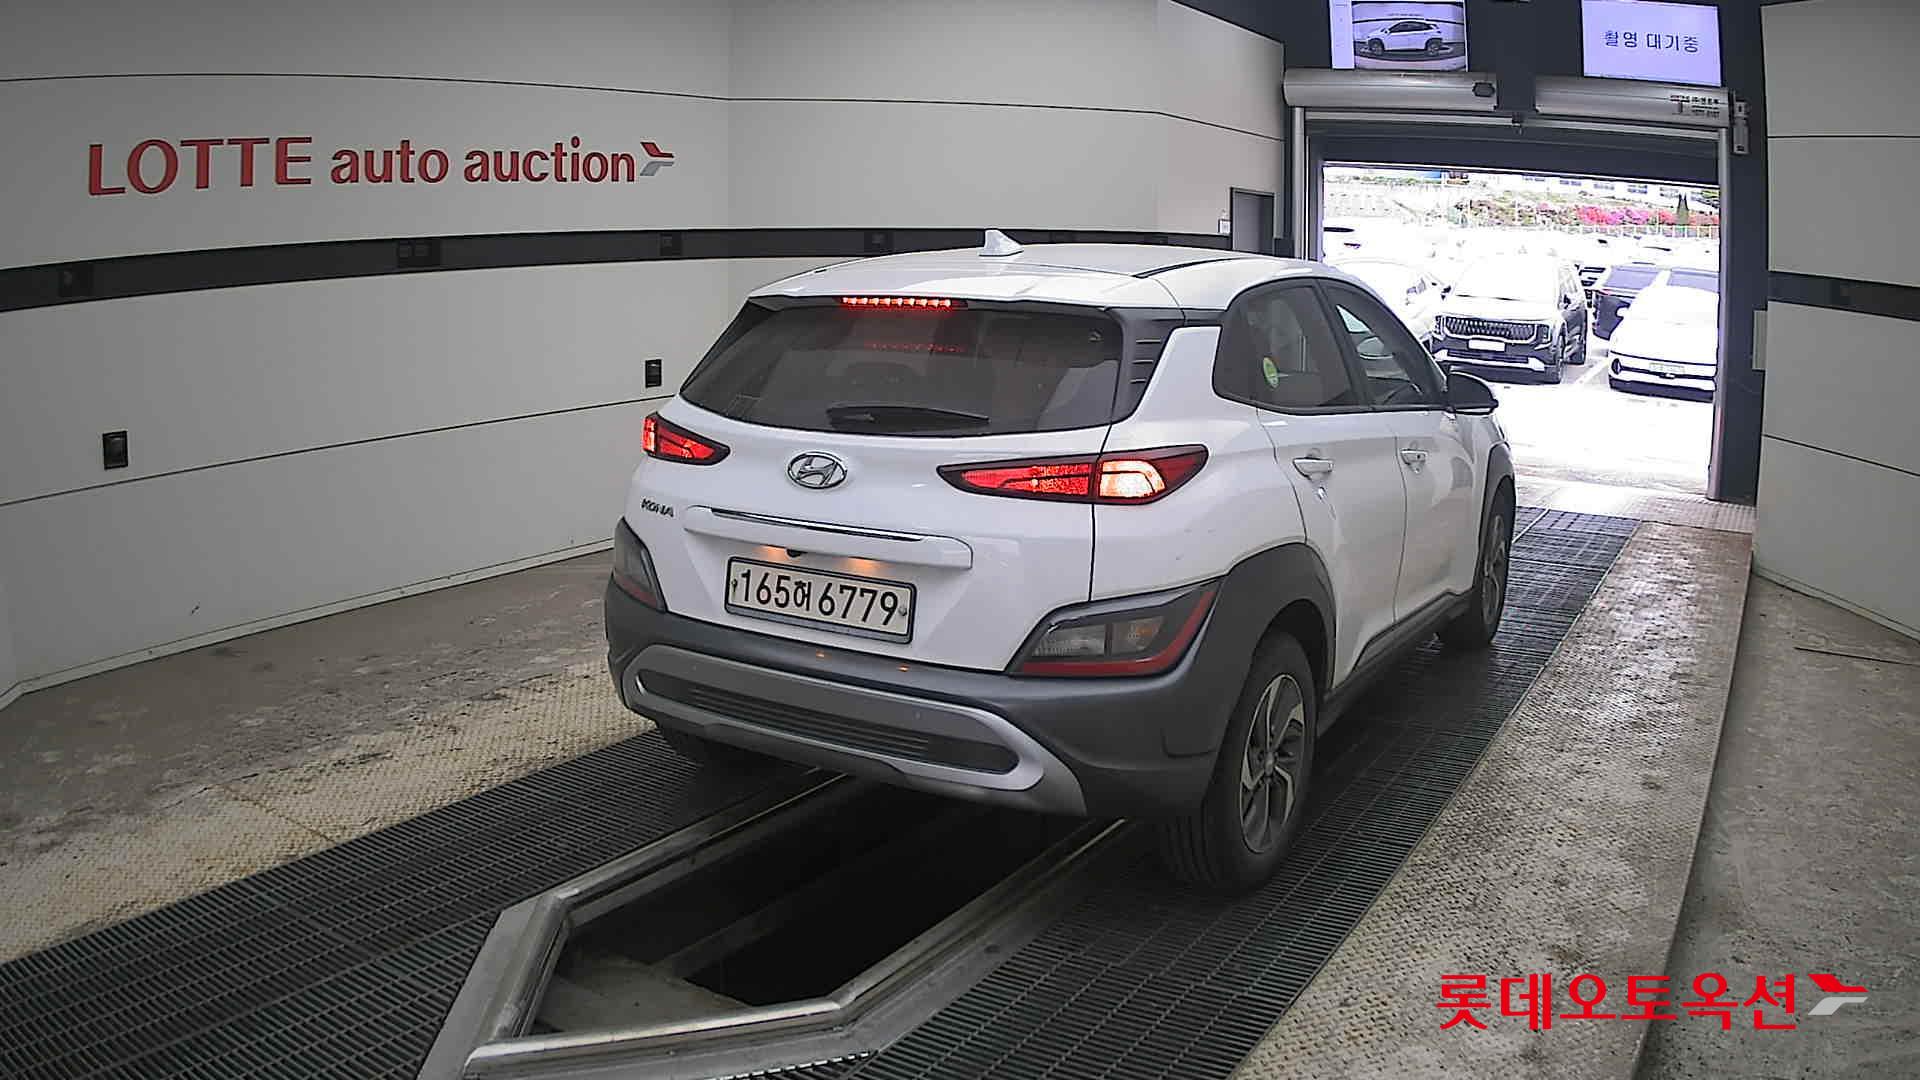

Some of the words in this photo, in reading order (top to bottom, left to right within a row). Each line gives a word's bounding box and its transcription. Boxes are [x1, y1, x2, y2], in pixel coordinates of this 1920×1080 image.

[1646, 33, 1698, 53] 대기중
[89, 137, 312, 196] LOTTE
[330, 139, 449, 184] auto
[463, 136, 635, 183] auction
[641, 498, 674, 517] KONA
